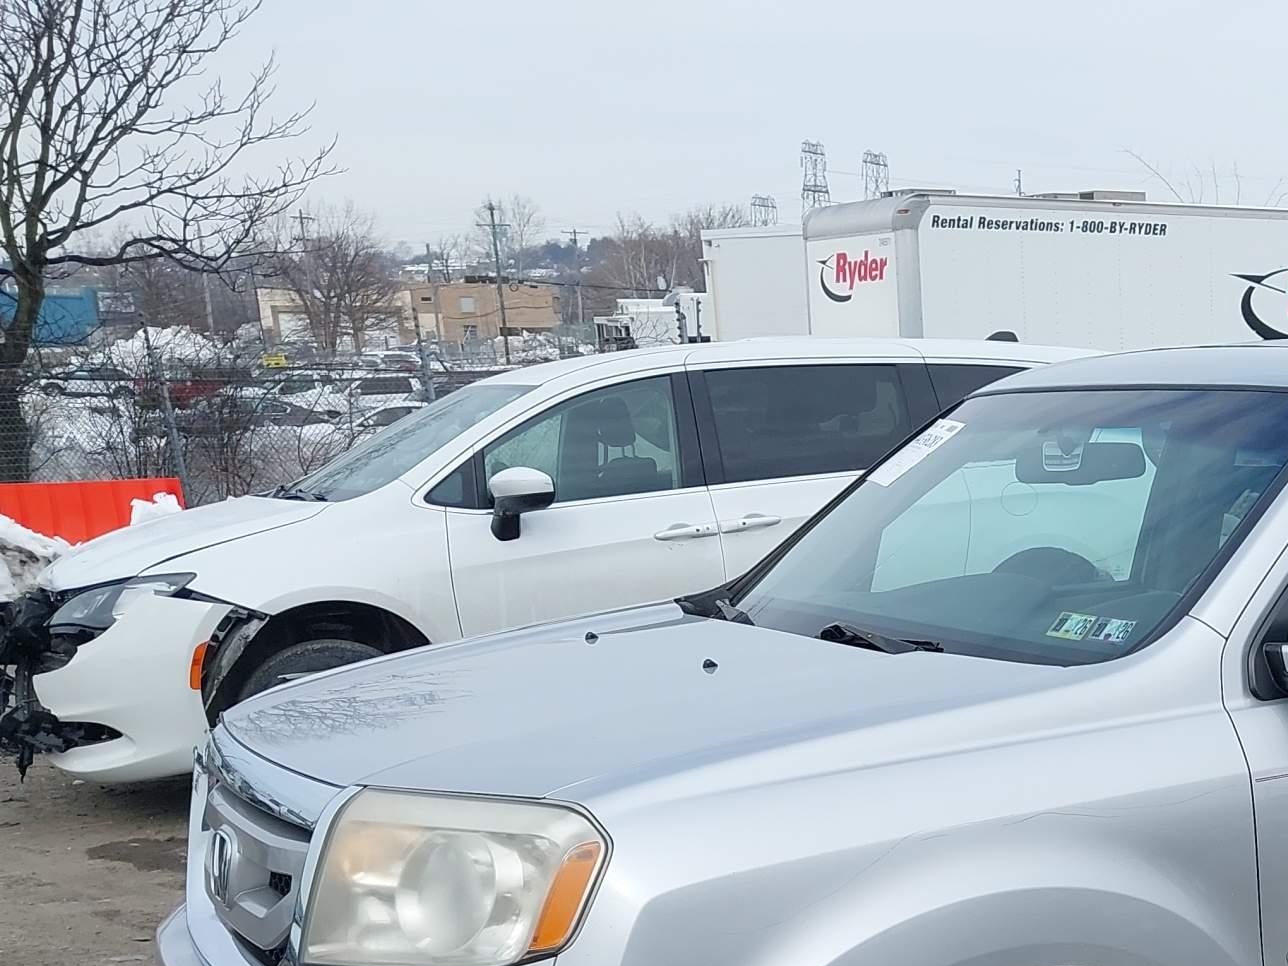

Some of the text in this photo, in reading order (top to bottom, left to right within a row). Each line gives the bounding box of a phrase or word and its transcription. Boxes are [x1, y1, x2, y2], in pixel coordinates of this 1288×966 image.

[931, 215, 1168, 236] Rental Reservations: 1-800-BY-RYDER
[835, 250, 888, 290] Ryder
